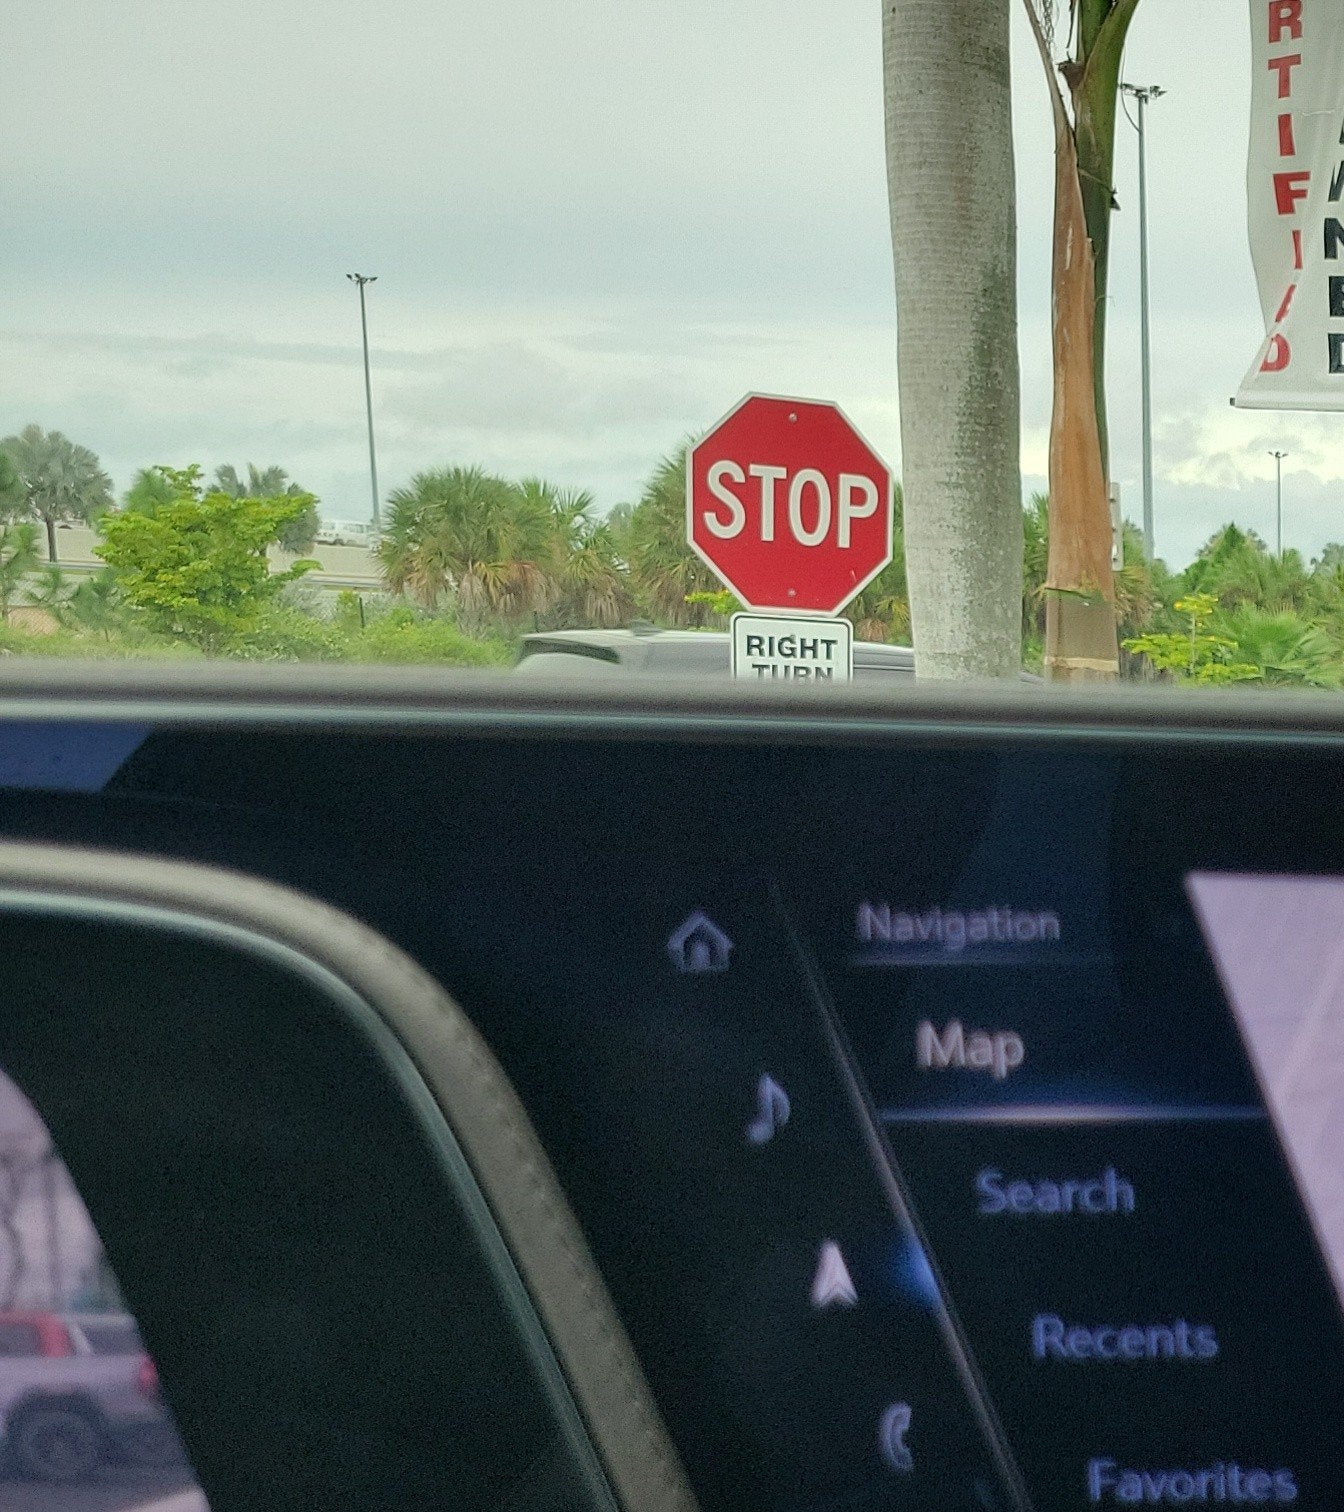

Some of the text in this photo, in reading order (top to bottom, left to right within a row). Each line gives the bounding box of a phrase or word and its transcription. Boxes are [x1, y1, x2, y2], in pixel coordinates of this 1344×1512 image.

[704, 460, 878, 548] STOP
[746, 634, 838, 661] RIGHT
[857, 902, 1061, 951] Navigation
[917, 1018, 1025, 1079] Map
[975, 1165, 1136, 1214] Search
[1030, 1312, 1221, 1361] Recents
[1087, 1455, 1299, 1502] Favorites
